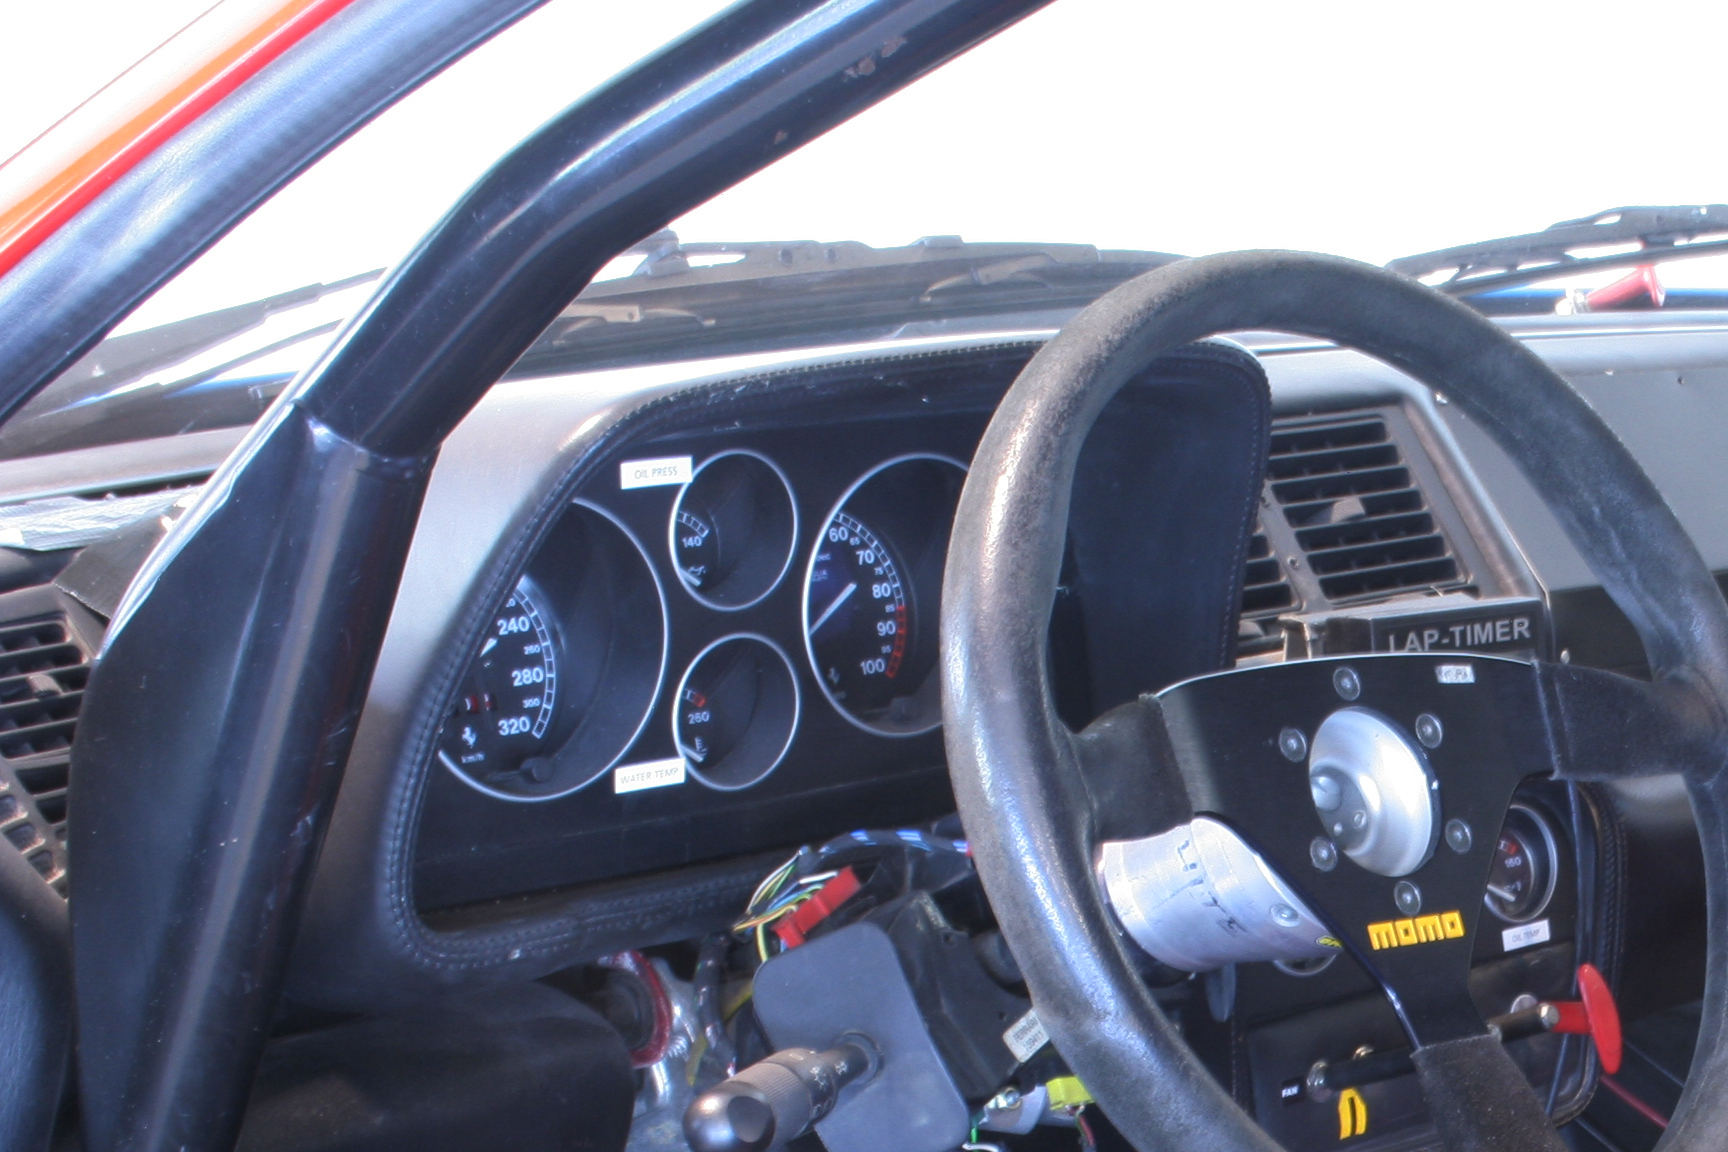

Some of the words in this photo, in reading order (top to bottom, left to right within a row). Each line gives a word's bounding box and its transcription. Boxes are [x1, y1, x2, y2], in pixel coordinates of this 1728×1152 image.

[634, 468, 649, 480] OIL
[652, 465, 678, 478] PRESS
[682, 535, 702, 548] 140
[829, 526, 848, 543] 60
[856, 550, 875, 565] 70
[872, 583, 891, 599] 80
[497, 615, 530, 636] 240
[877, 620, 897, 637] 90
[1389, 617, 1531, 652] LAP-TIMER
[860, 658, 885, 675] 100
[512, 667, 544, 687] 280
[523, 698, 541, 709] 300
[498, 716, 530, 736] 320
[620, 771, 652, 784] WATER
[654, 766, 679, 779] TEMP
[1281, 1084, 1300, 1098] FAN
